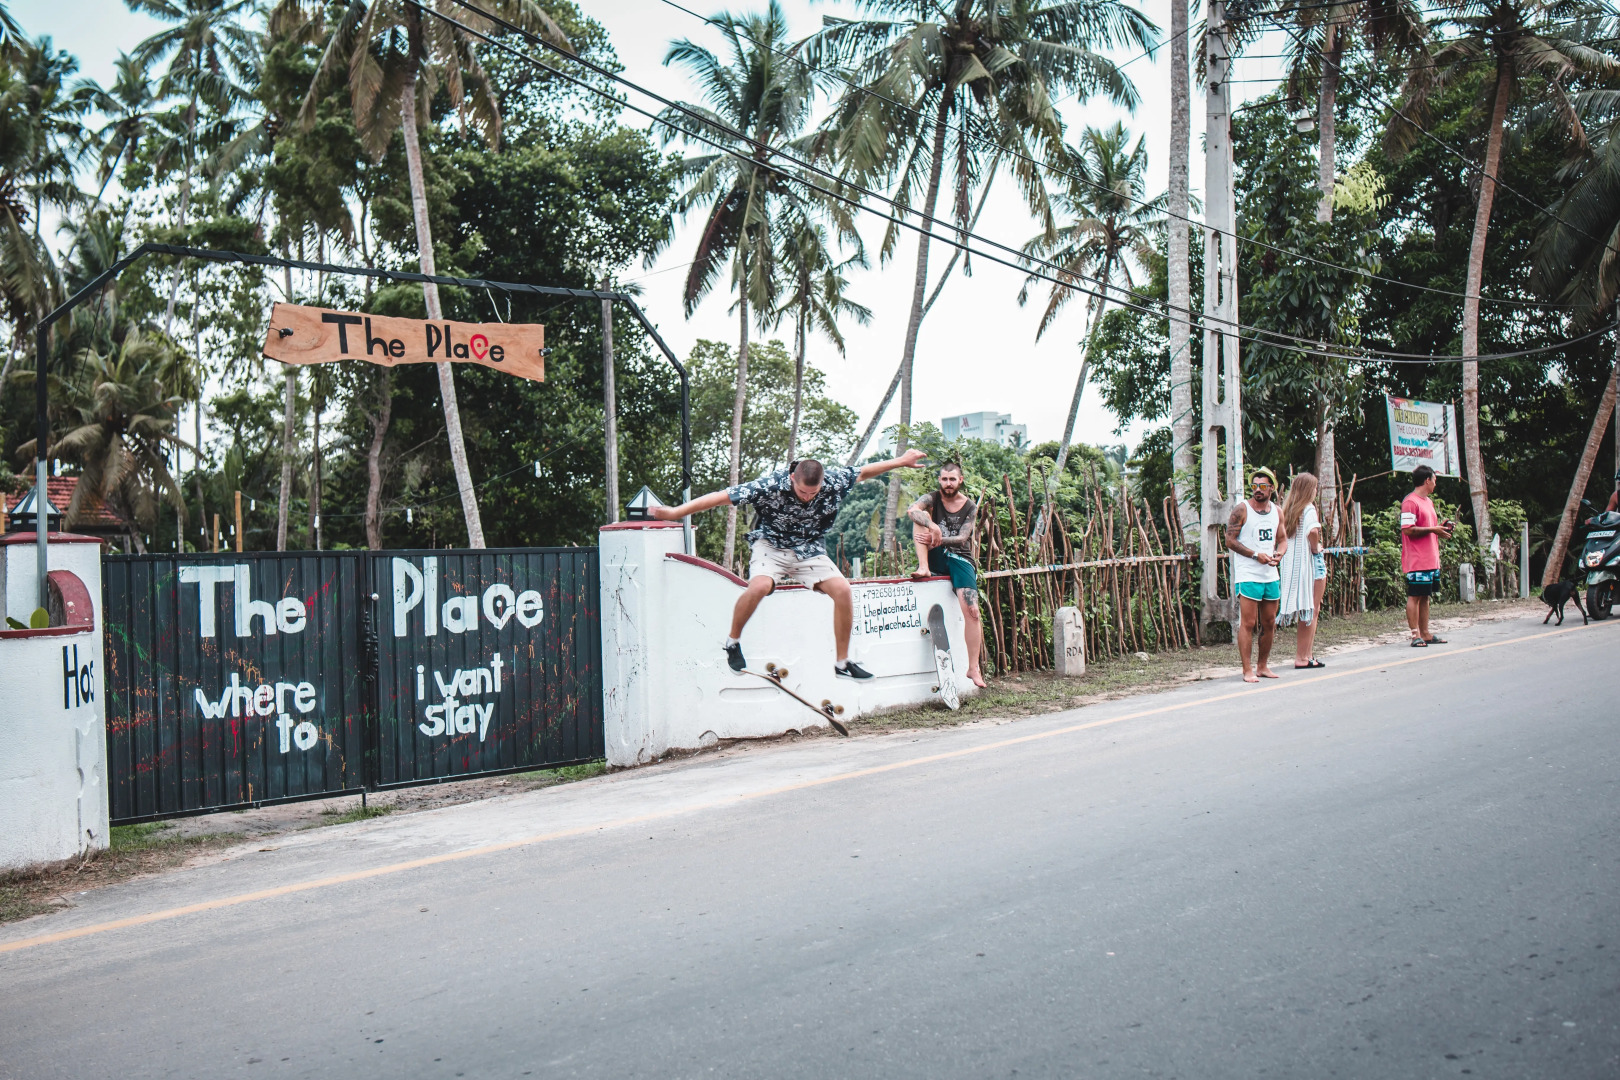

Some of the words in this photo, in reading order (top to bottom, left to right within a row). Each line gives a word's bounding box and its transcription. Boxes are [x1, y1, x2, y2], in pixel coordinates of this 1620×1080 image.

[321, 312, 405, 358] The
[425, 323, 504, 362] Place
[1394, 408, 1403, 423] WE
[1403, 409, 1429, 427] CHANGED
[1396, 425, 1405, 434] THE
[1405, 426, 1430, 437] LOCATION
[1259, 528, 1272, 541] DC
[179, 564, 307, 638] The
[392, 556, 544, 637] Place
[863, 586, 914, 600] +79265819916
[863, 597, 917, 620] theplacehostel
[864, 613, 922, 639] theplacehostel
[1066, 646, 1083, 657] RDA
[195, 672, 316, 719] where
[416, 664, 425, 700] i
[433, 652, 504, 698] want
[275, 713, 319, 754] to
[418, 696, 494, 742] stay
